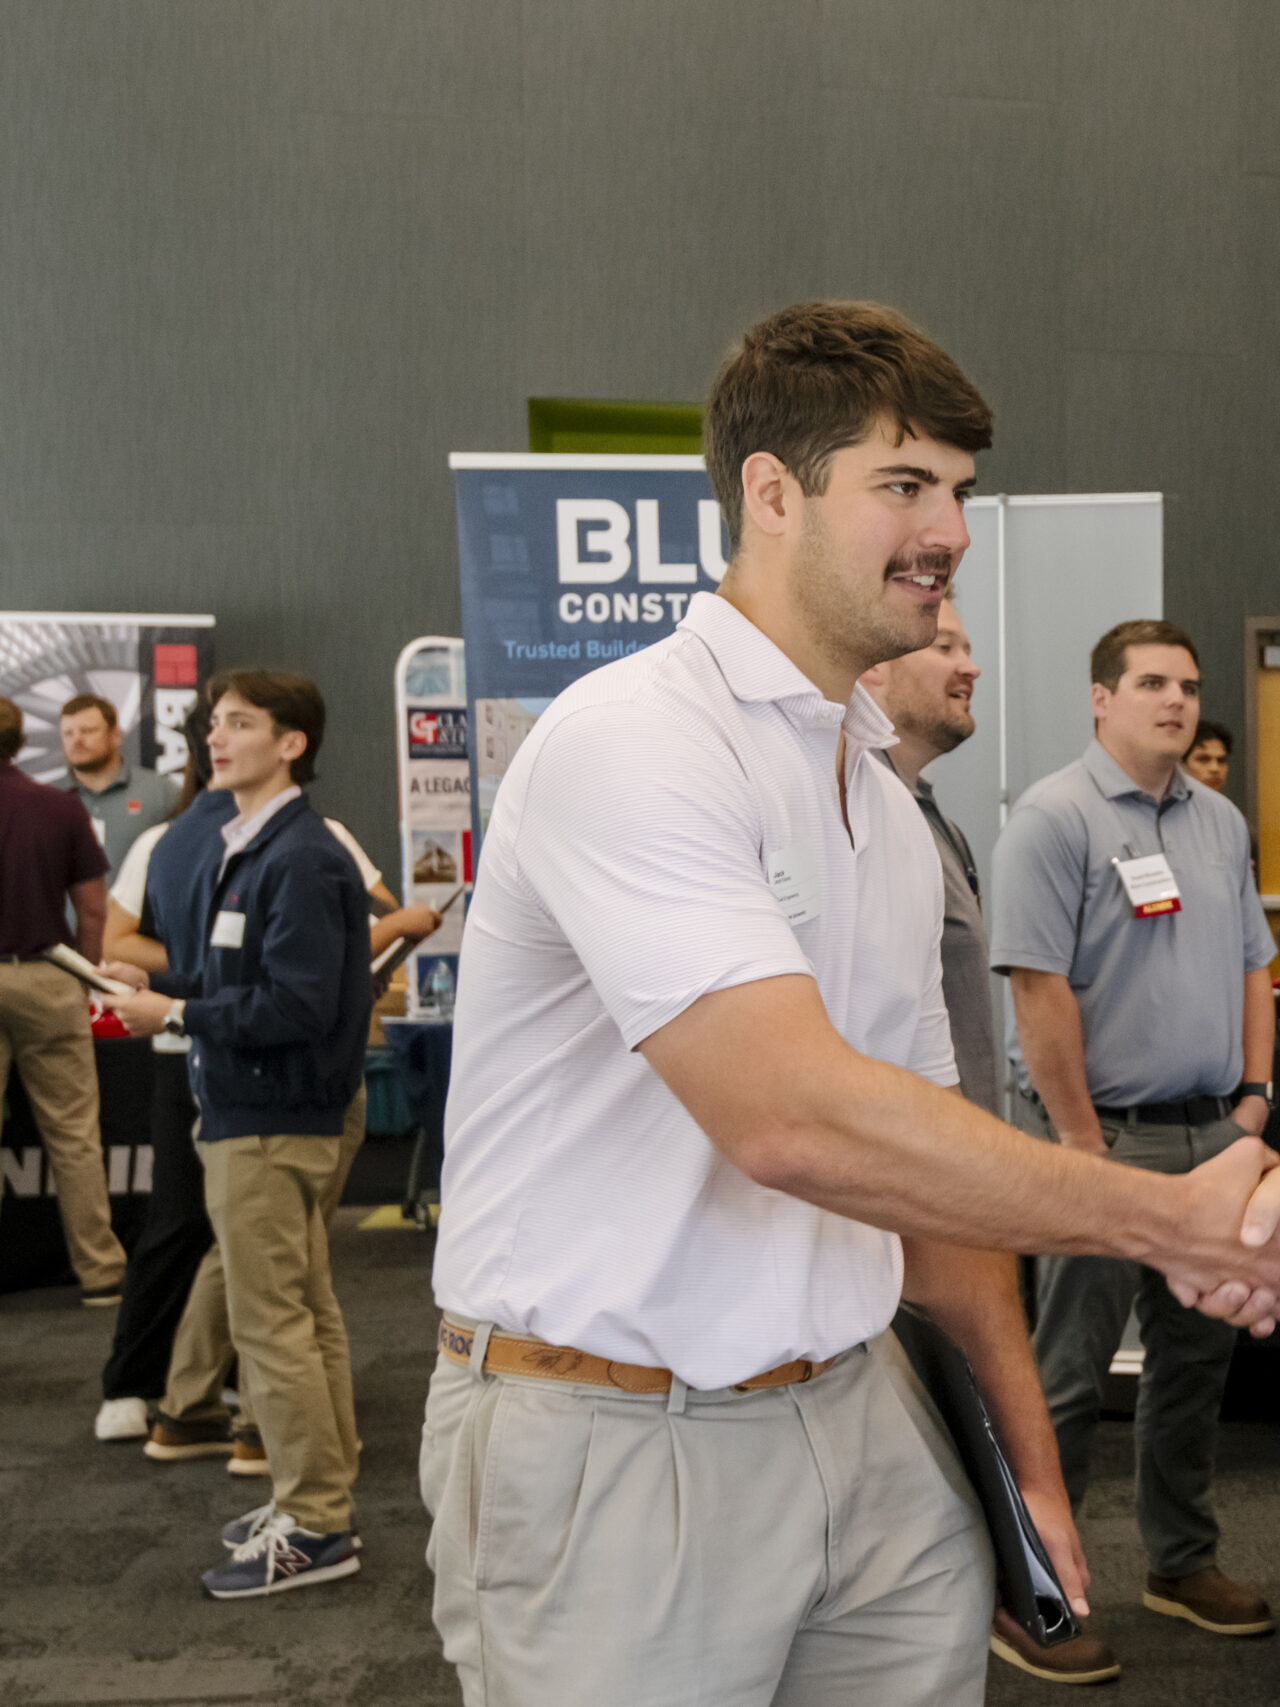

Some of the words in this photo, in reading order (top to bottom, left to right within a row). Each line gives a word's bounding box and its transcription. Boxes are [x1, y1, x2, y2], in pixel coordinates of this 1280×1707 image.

[559, 592, 694, 624] CONST
[504, 640, 580, 659] Trusted
[411, 778, 421, 793] A
